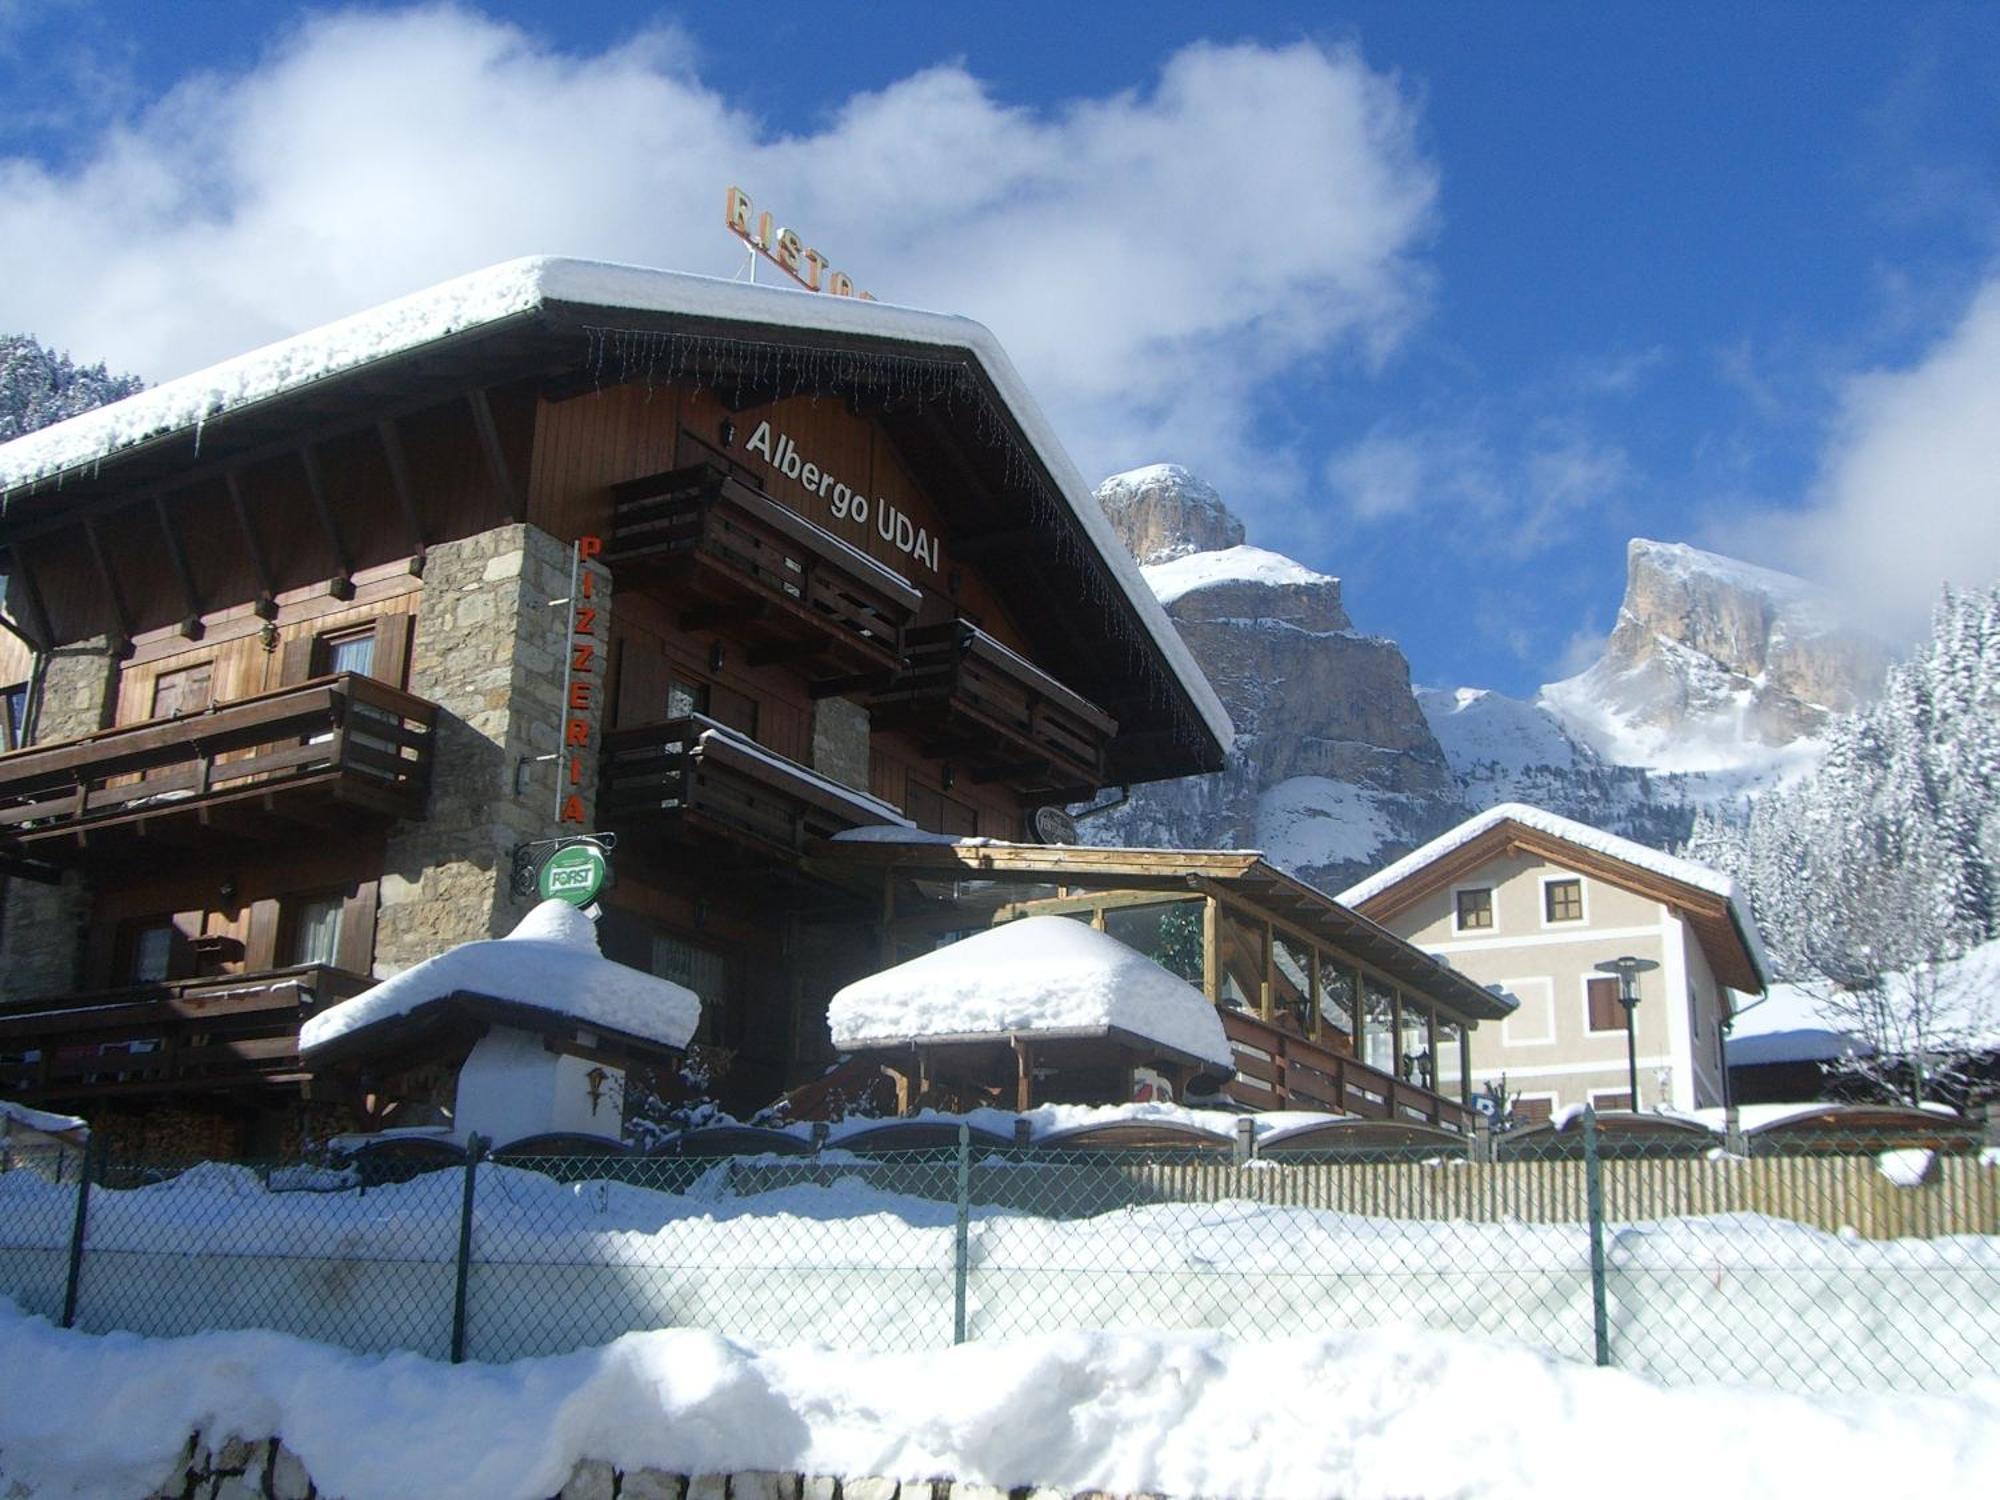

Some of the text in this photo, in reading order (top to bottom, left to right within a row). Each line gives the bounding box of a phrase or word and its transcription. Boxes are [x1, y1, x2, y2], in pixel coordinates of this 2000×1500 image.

[727, 186, 877, 300] RISTO
[746, 421, 939, 573] Albergo UDAI
[561, 536, 602, 824] PIZZERIA
[552, 868, 592, 887] FORST
